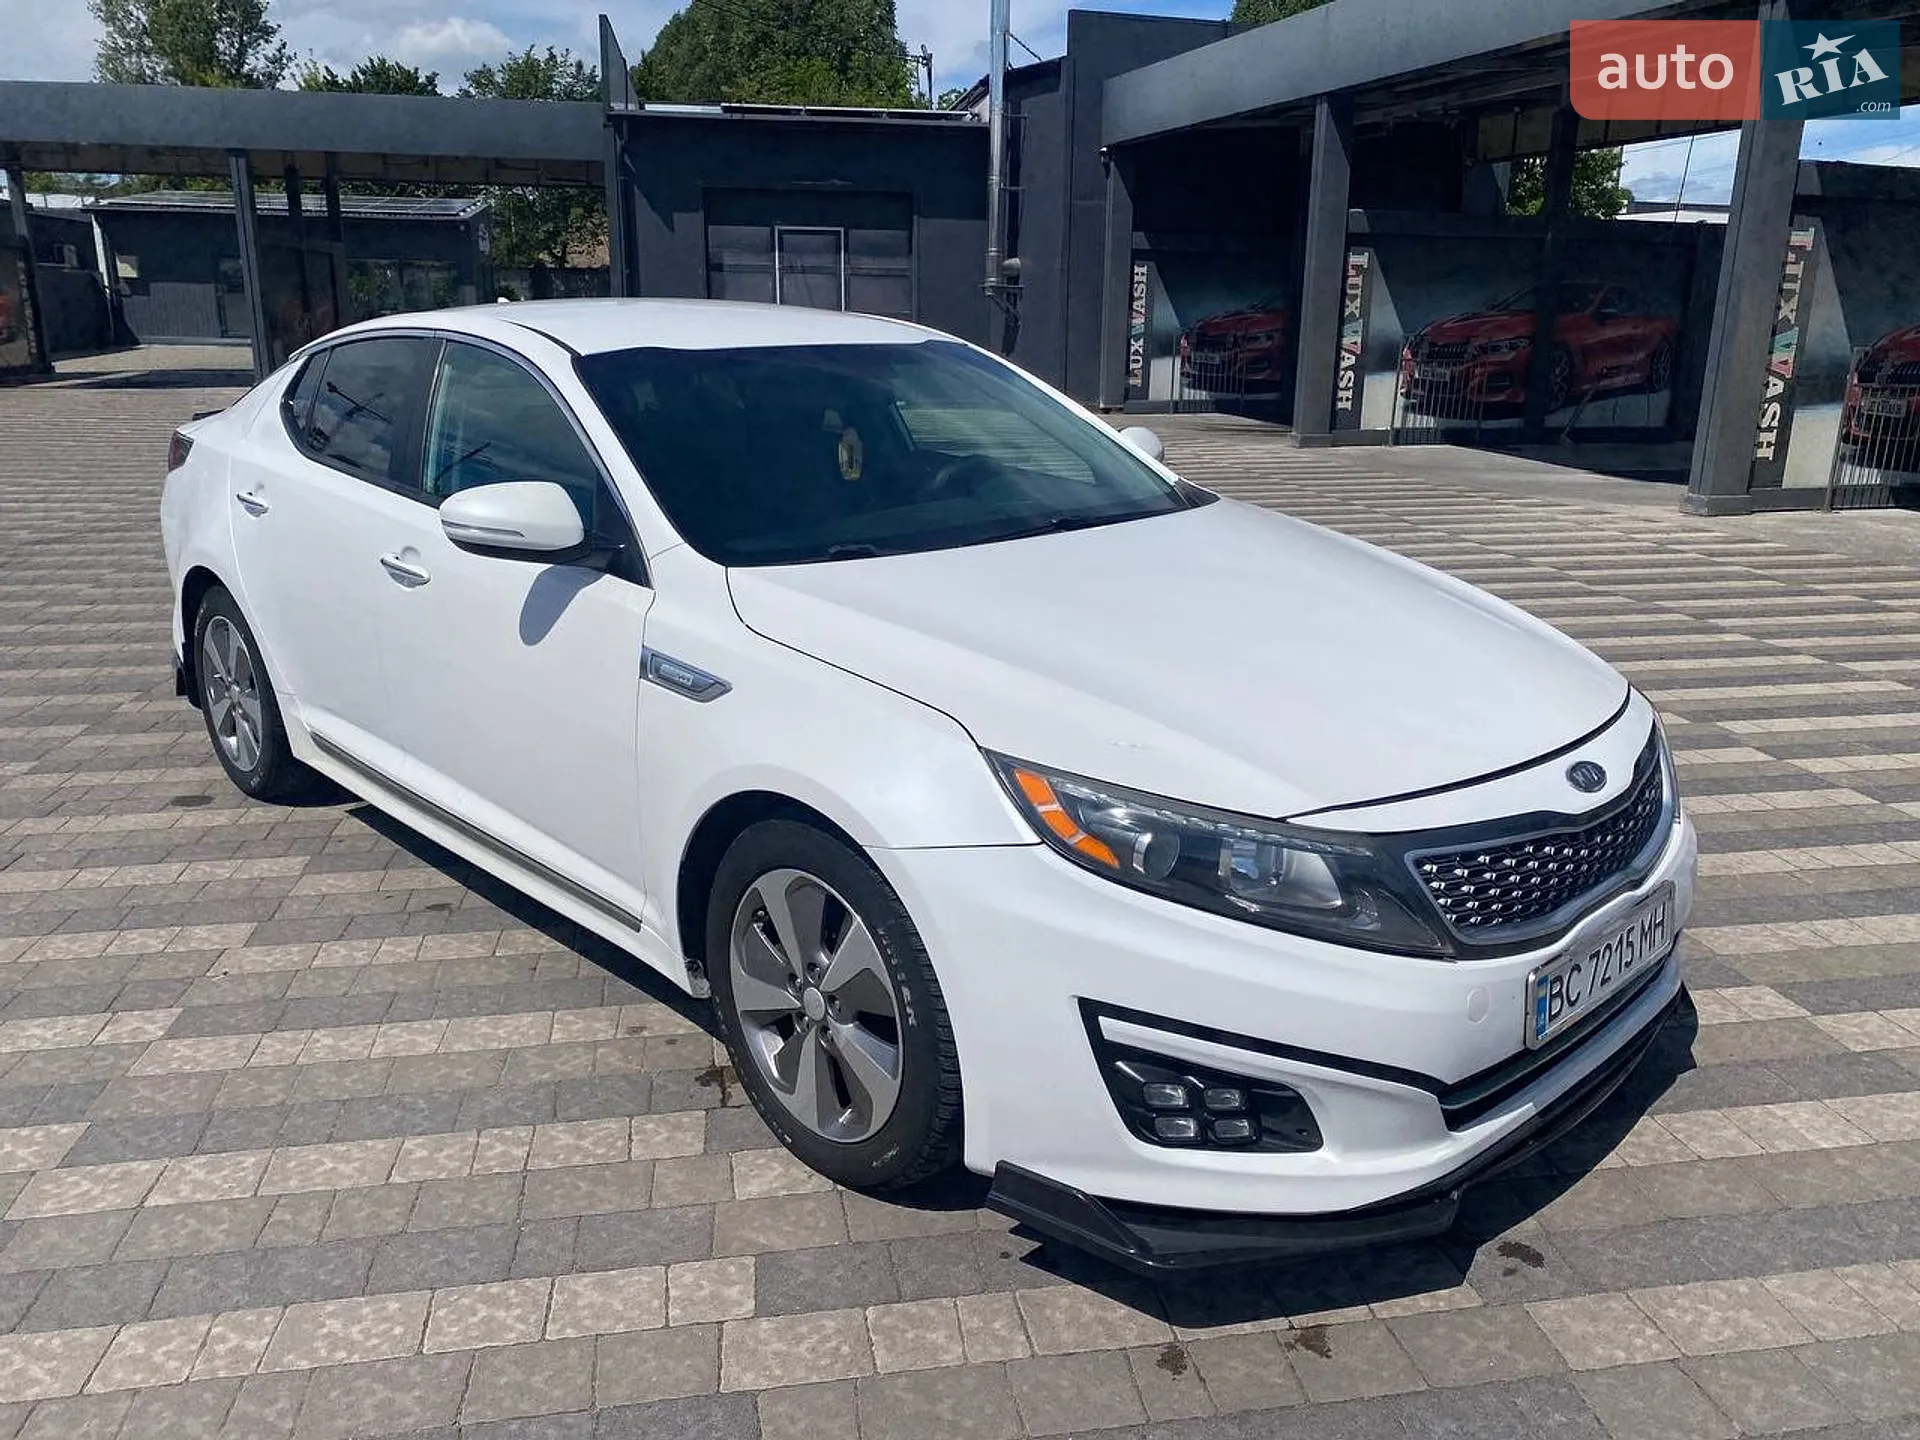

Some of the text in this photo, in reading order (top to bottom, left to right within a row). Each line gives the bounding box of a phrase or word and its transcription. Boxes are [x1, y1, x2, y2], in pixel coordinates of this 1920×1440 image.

[1129, 264, 1148, 387] LUX WASH
[1337, 252, 1369, 412] LUX WASH
[1755, 326, 1799, 461] WASH
[1549, 901, 1665, 1022] BC 7215 MH
